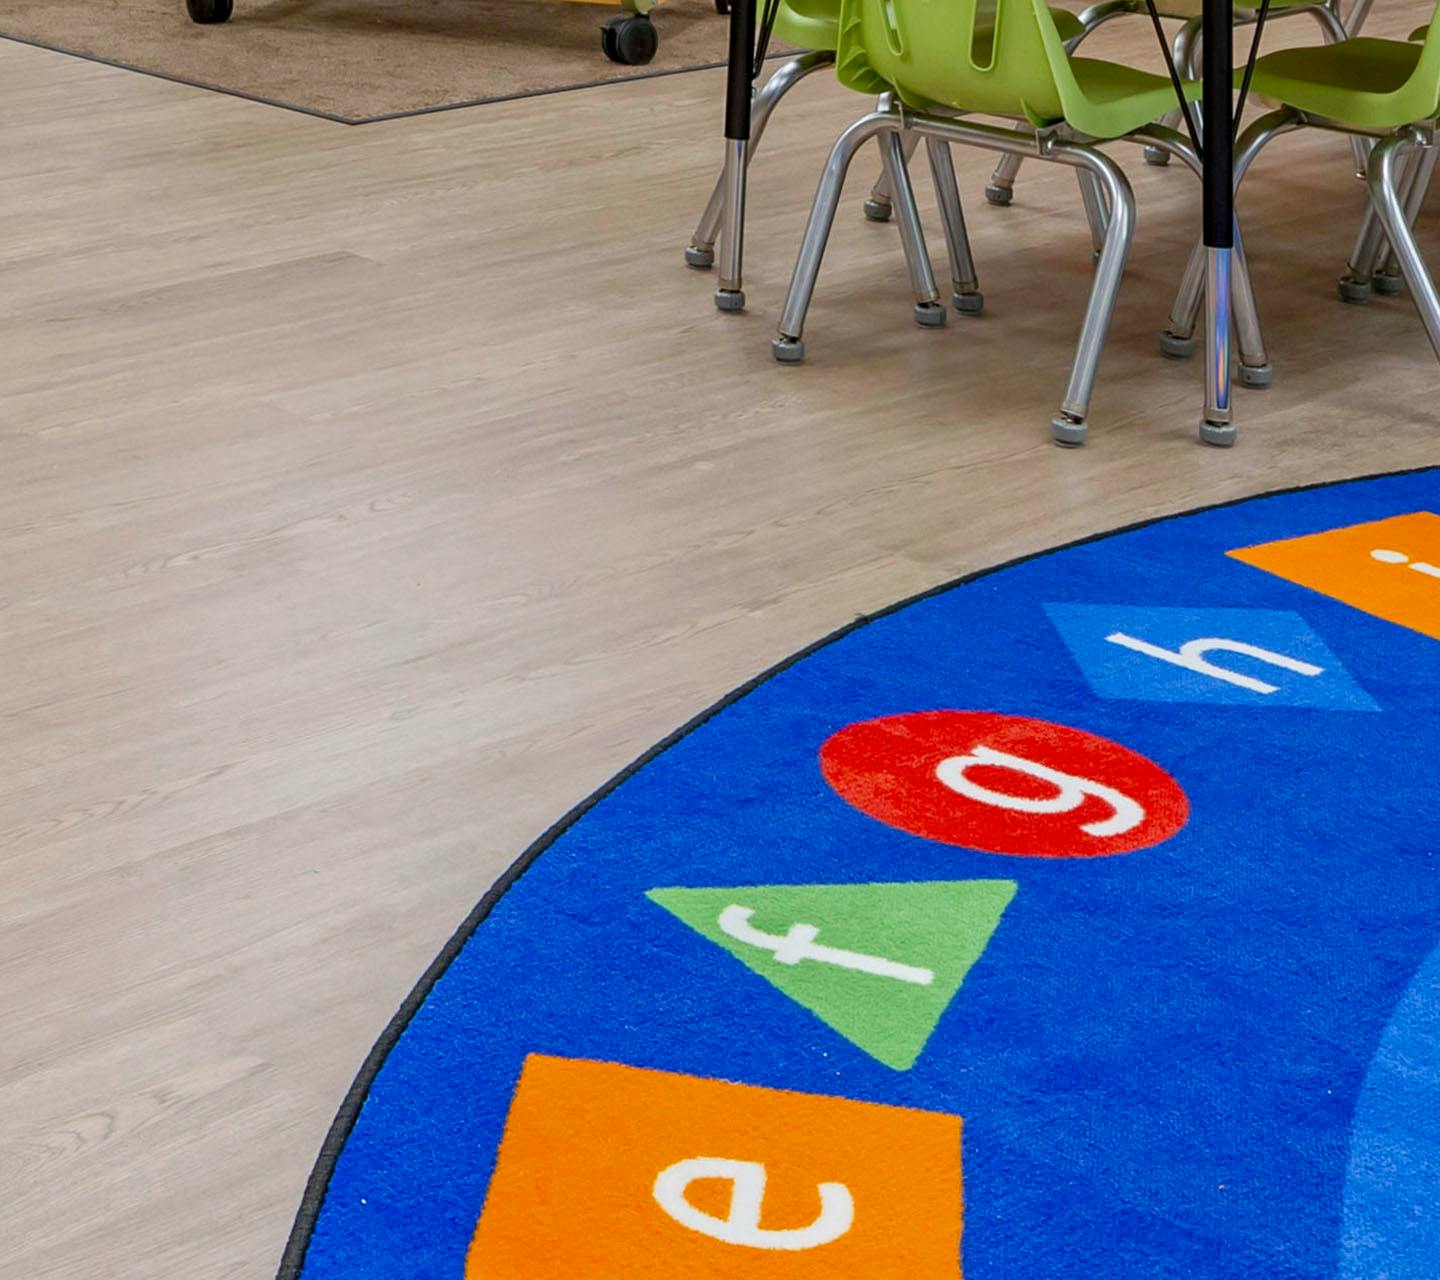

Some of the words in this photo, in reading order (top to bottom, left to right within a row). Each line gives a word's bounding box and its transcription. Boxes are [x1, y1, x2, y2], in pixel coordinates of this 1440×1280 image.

[1108, 633, 1322, 694] h
[935, 746, 1145, 837] g
[717, 903, 937, 987] f
[653, 1157, 854, 1251] e
